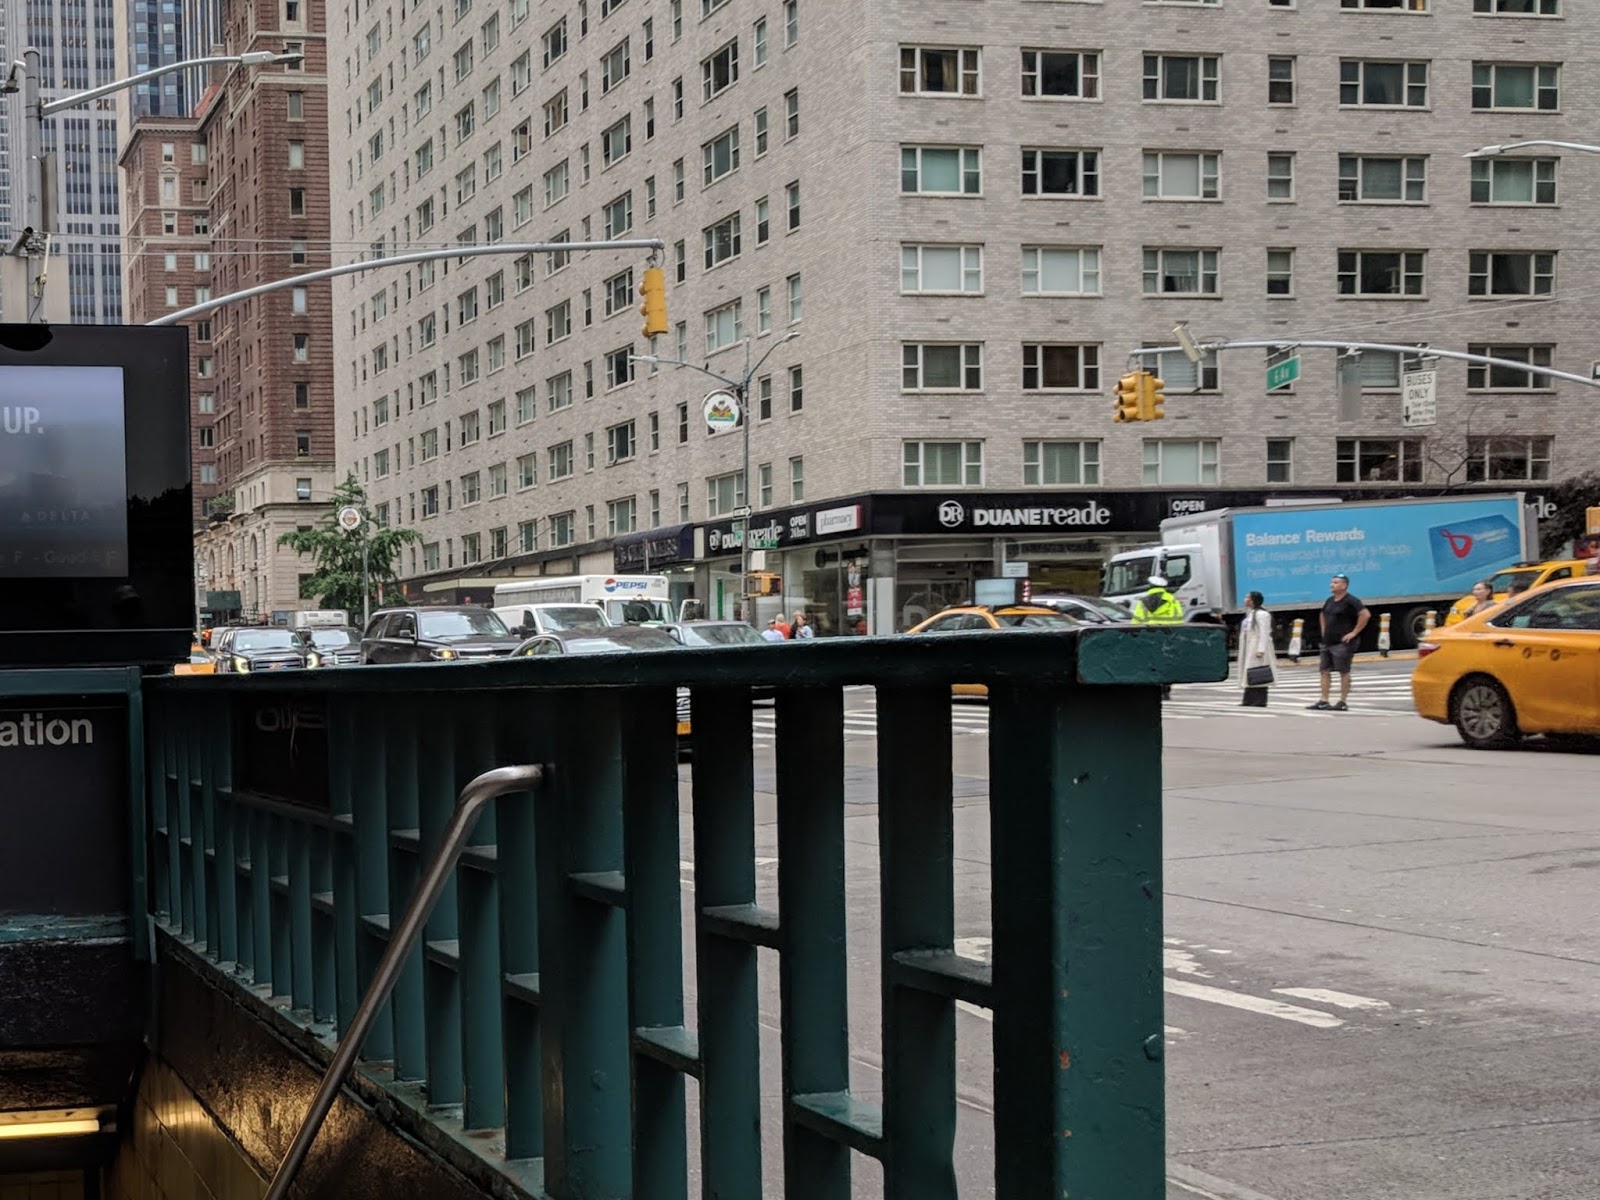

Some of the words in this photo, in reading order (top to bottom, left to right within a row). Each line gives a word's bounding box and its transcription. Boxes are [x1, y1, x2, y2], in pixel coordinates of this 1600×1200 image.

[1406, 374, 1432, 387] BUSES
[1409, 388, 1430, 400] ONLY
[3, 406, 44, 434] UP.
[1171, 500, 1205, 512] OPEN
[789, 514, 807, 528] OPEN
[1246, 532, 1301, 546] Balance
[1305, 527, 1365, 543] Rewards
[615, 581, 648, 590] PEPSI
[0, 713, 93, 746] ation
